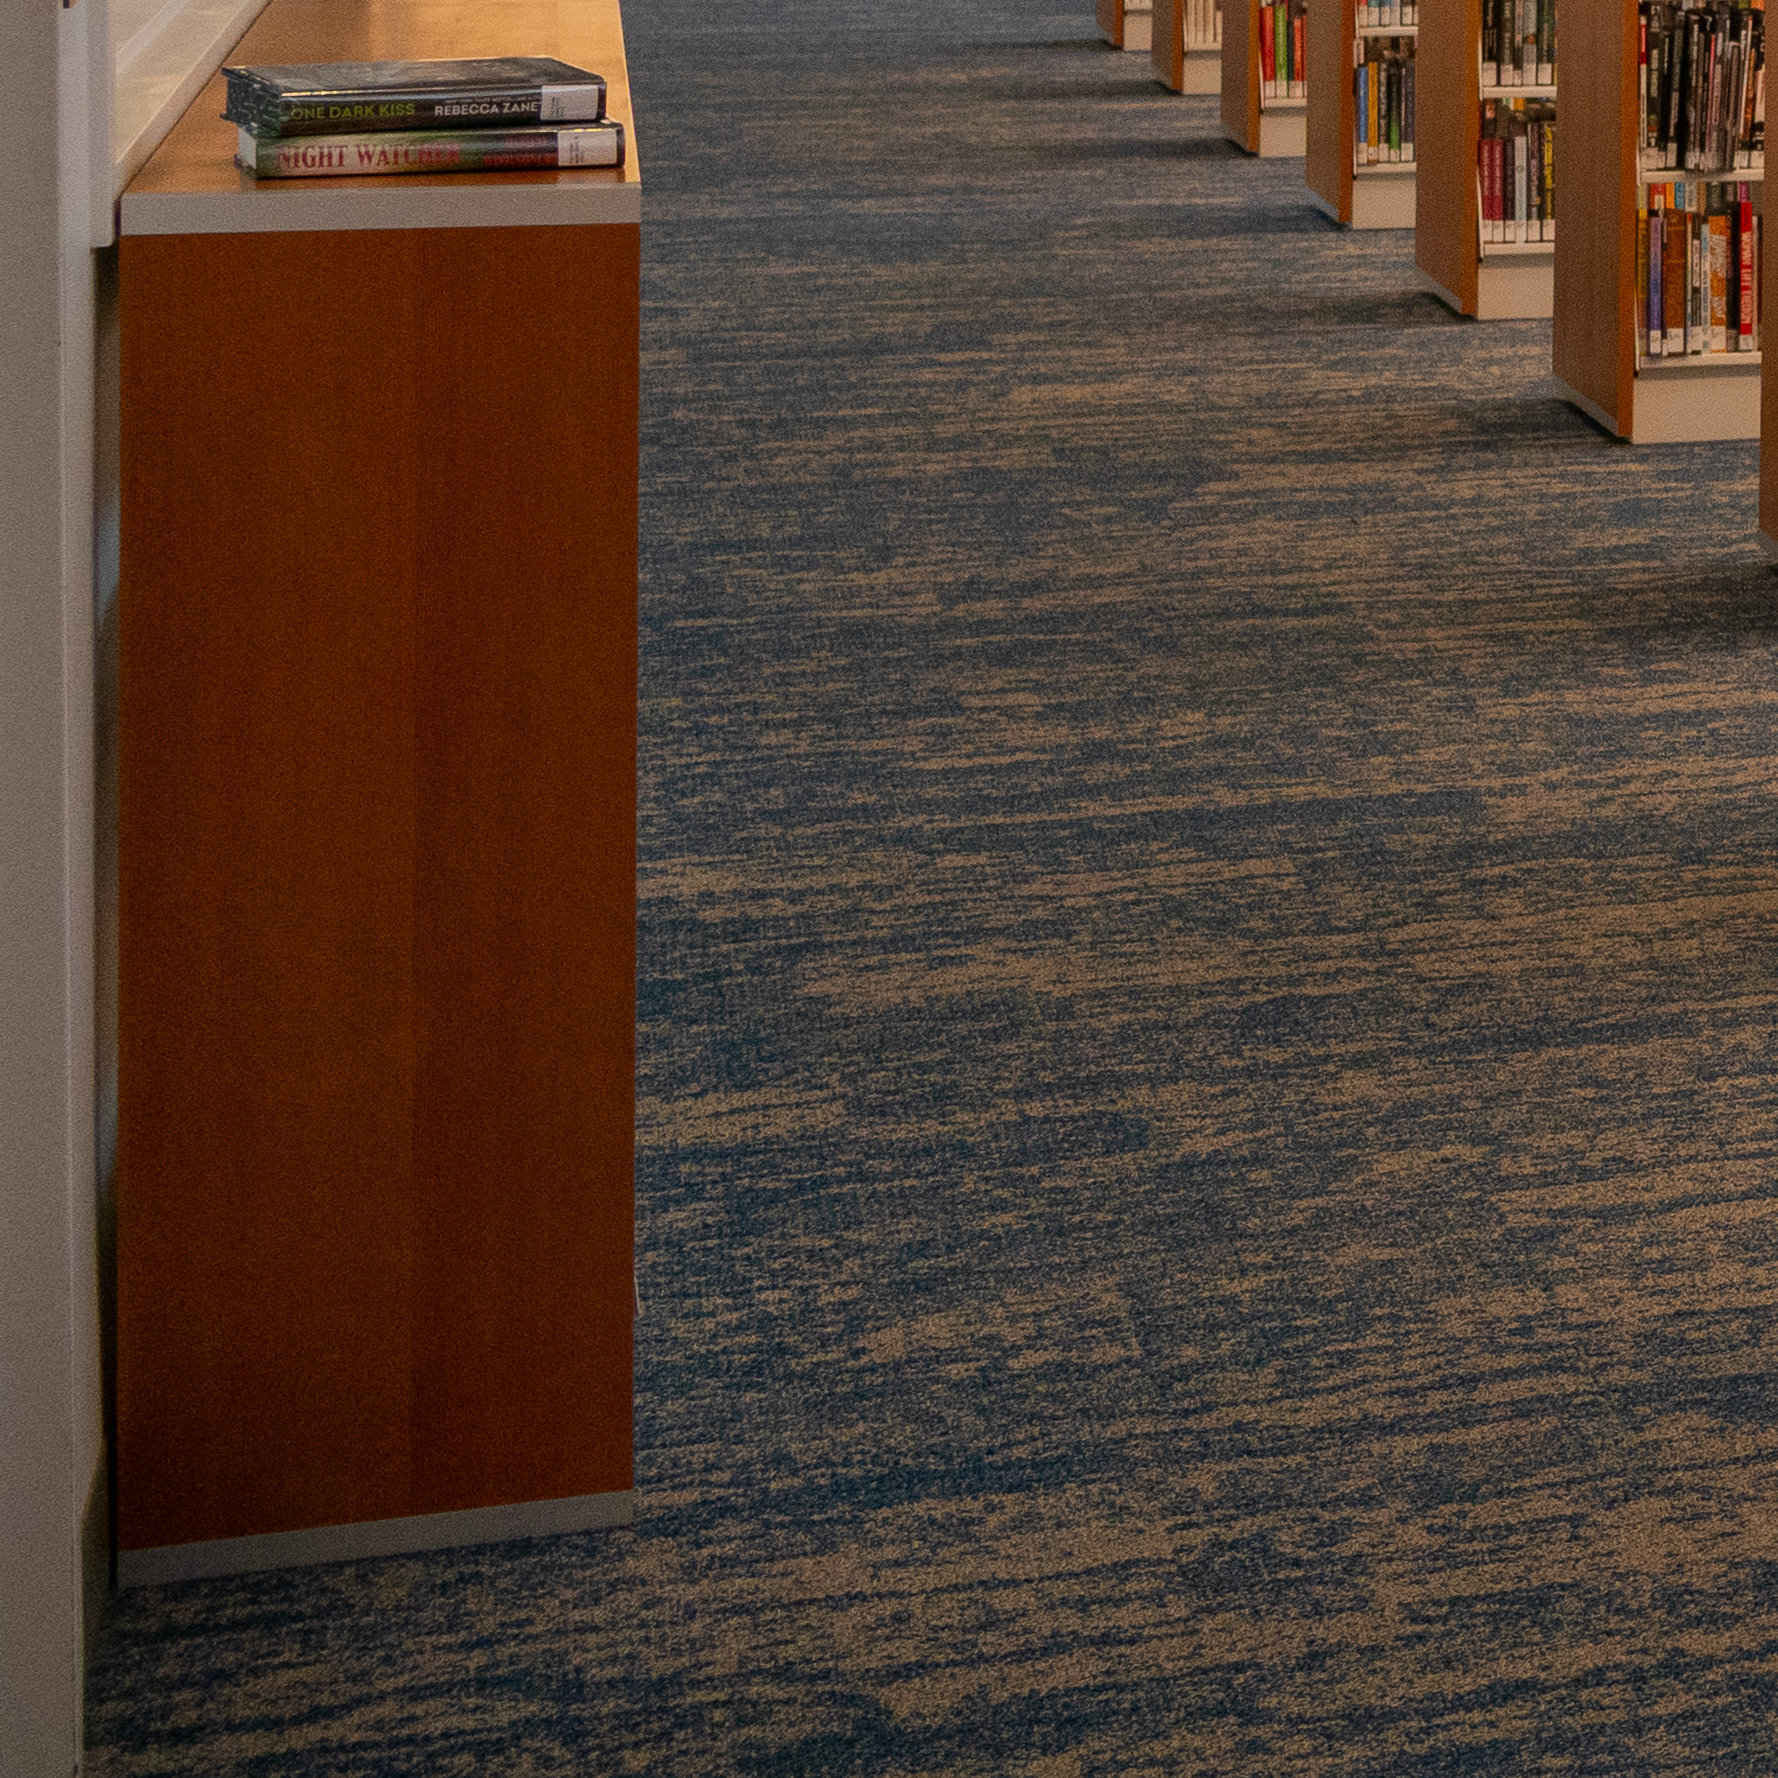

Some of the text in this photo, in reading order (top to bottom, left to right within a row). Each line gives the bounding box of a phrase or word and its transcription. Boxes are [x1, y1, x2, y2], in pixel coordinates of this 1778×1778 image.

[290, 103, 416, 121] ONE DARK KISS
[434, 101, 499, 117] REBECCA
[276, 144, 347, 170] NIGHT
